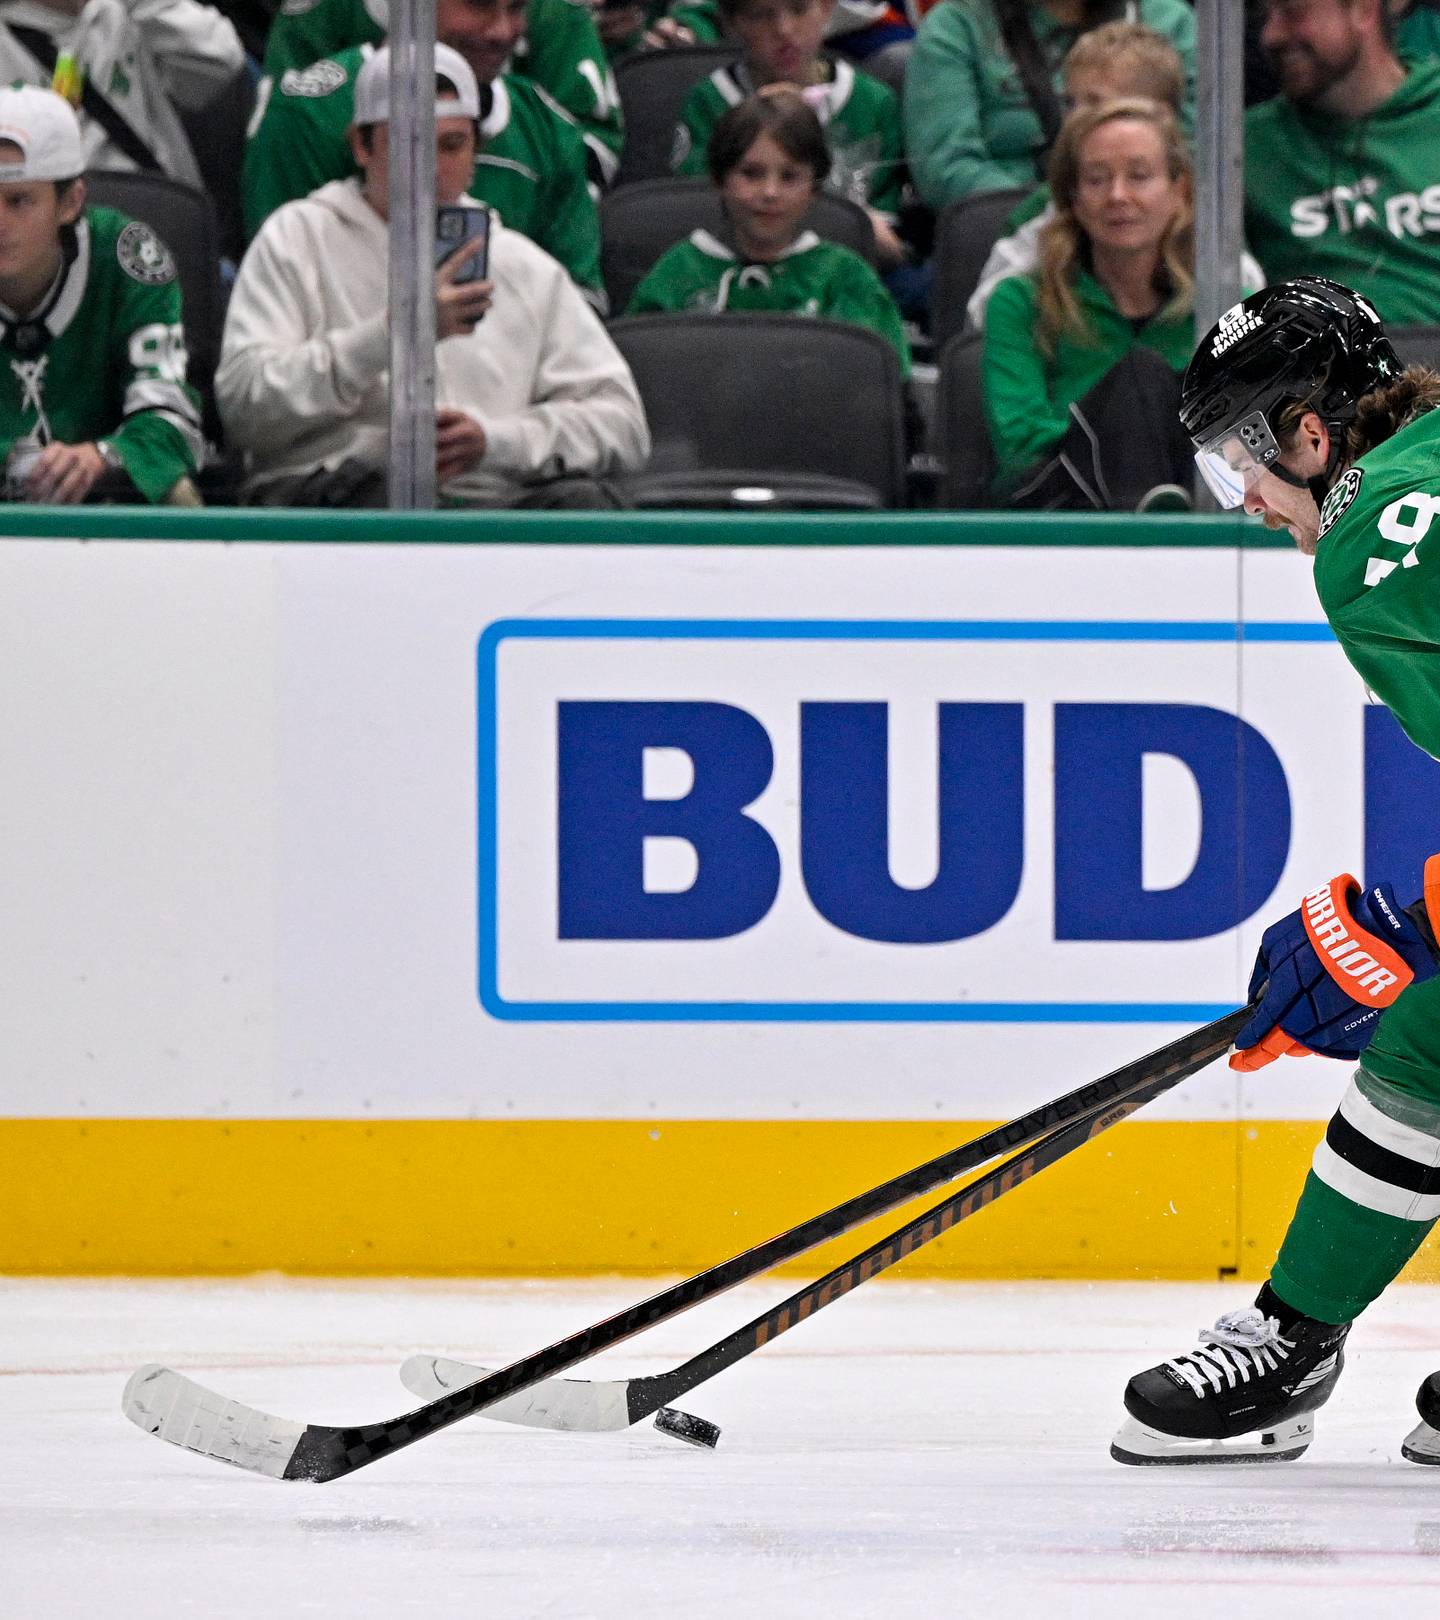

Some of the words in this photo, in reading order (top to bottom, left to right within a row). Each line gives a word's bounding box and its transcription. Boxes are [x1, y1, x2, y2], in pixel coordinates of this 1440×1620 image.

[1210, 315, 1265, 358] TRANSFER
[557, 700, 1291, 943] BUD
[1305, 883, 1398, 997] ARRIOR
[1344, 1009, 1380, 1032] COVERT
